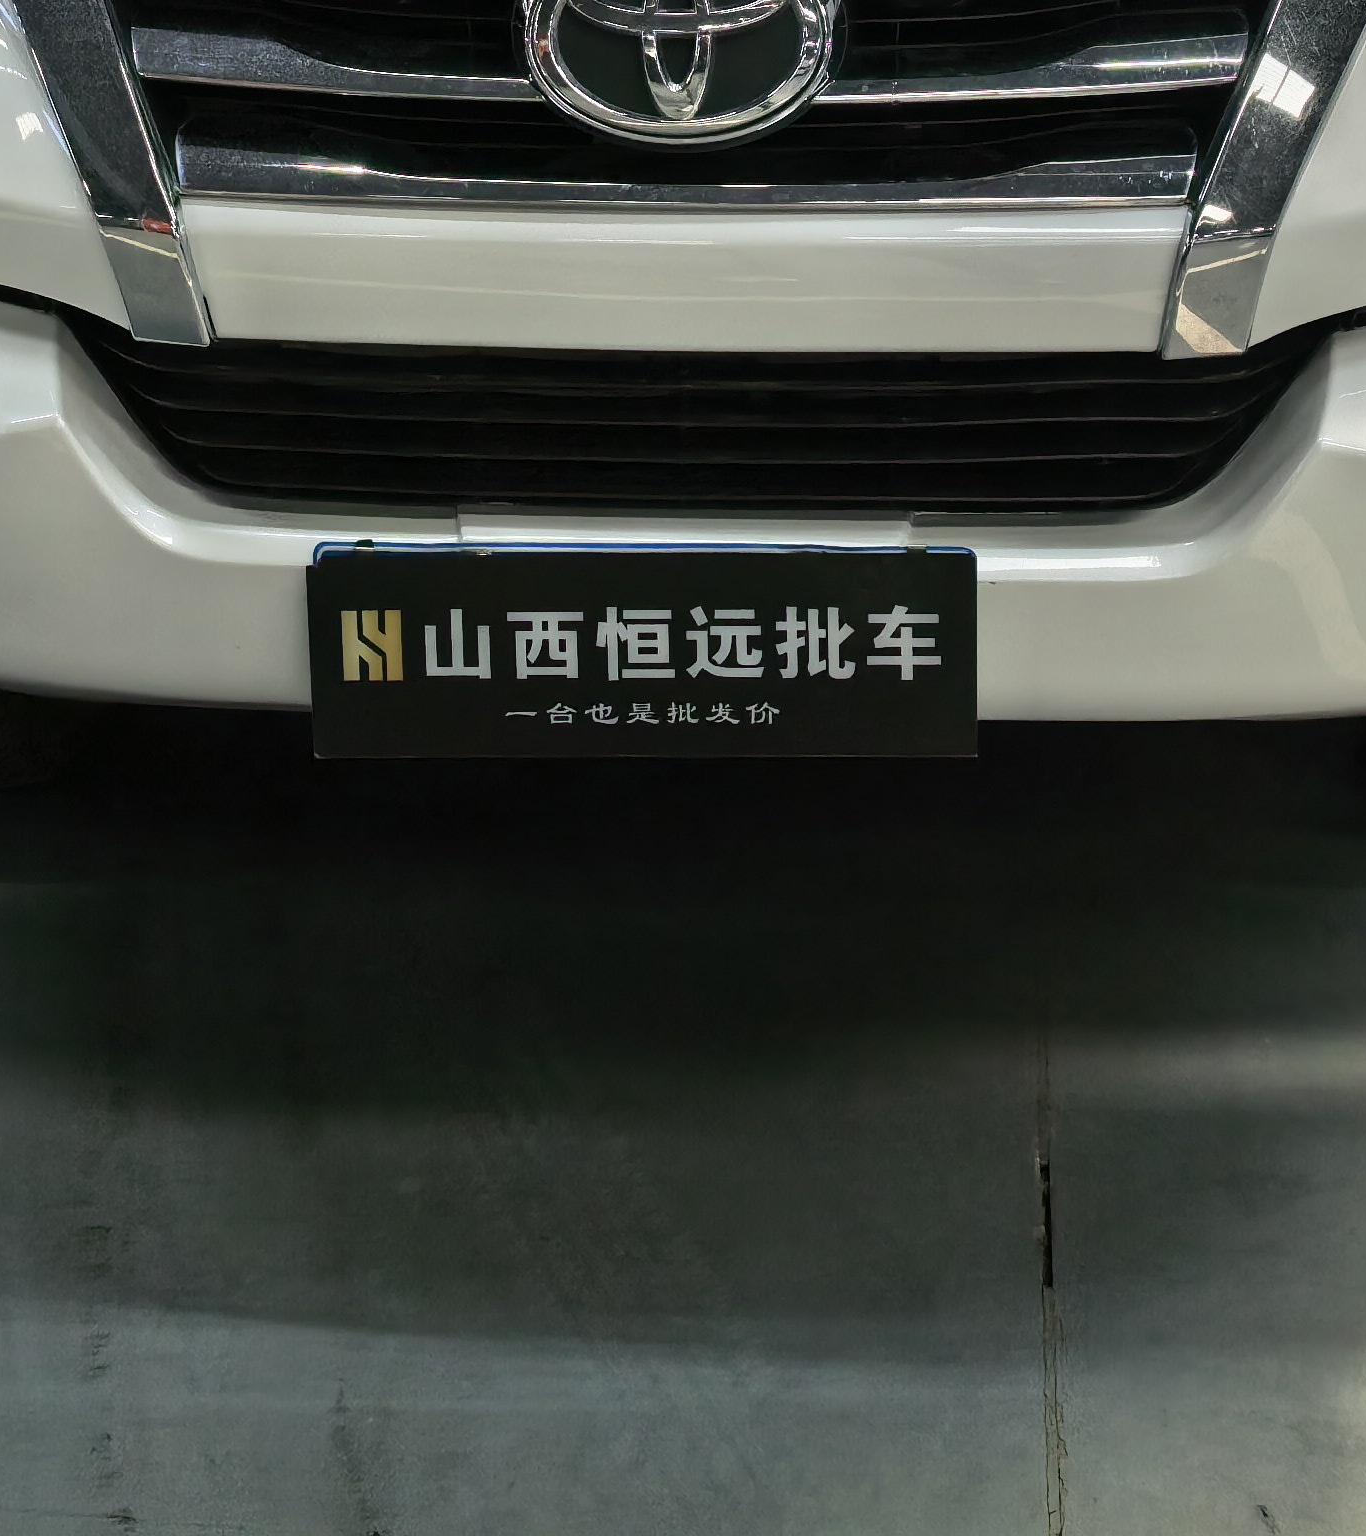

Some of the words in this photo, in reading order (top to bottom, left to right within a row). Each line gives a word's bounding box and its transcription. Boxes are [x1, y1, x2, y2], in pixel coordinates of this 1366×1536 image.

[423, 605, 942, 681] 山西恒远批车
[505, 701, 781, 726] 一台也是批发价
